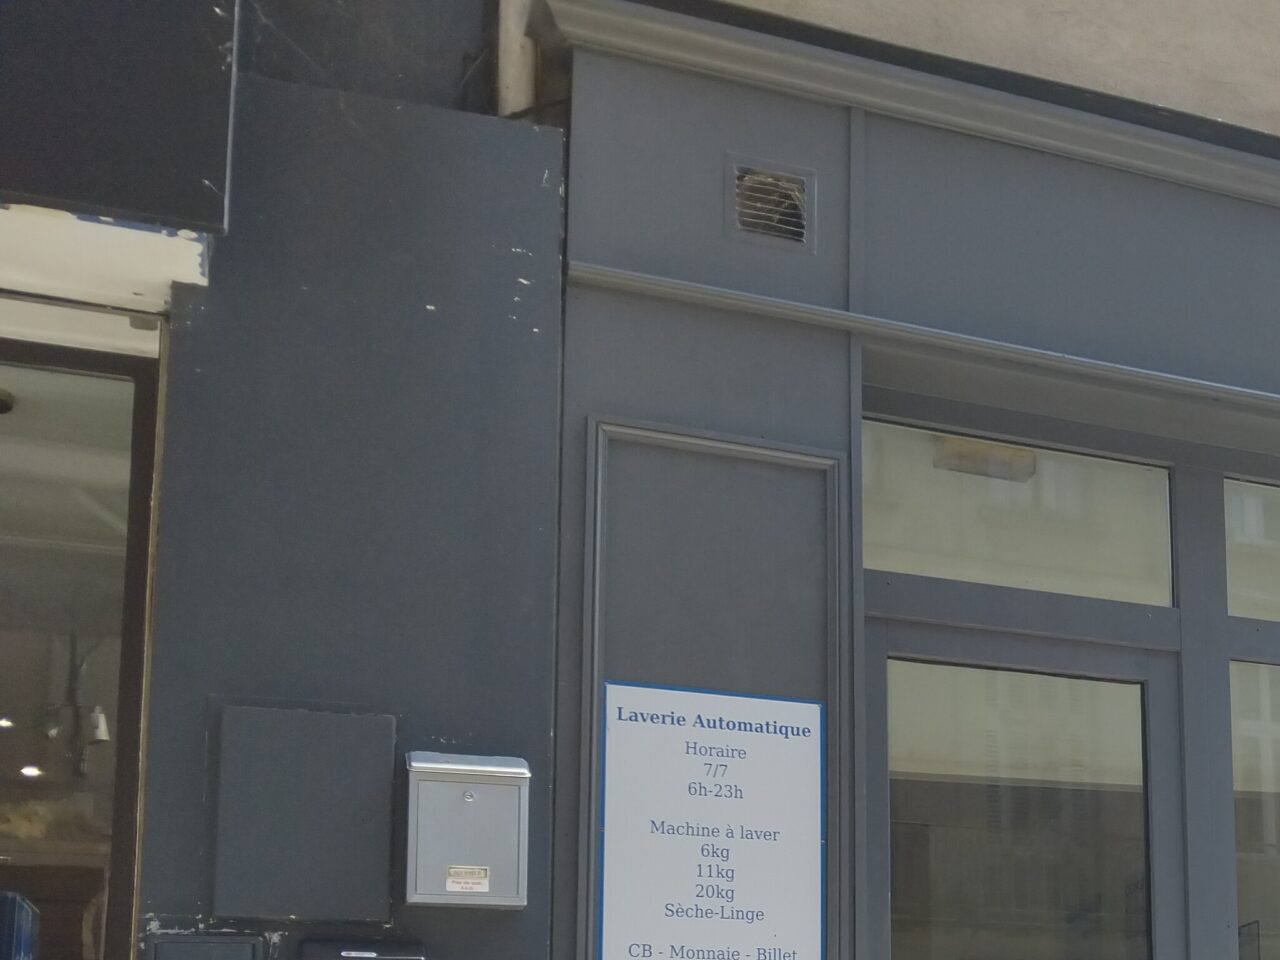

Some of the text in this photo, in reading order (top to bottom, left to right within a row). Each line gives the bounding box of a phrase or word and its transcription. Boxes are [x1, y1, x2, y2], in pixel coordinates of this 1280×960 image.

[616, 706, 812, 739] Laverie Automatique
[685, 741, 747, 760] Horaire
[703, 763, 728, 778] 7/7
[688, 782, 743, 799] 6h-23h
[649, 820, 780, 842] Machine à laver
[700, 844, 730, 861] 6kg
[696, 864, 735, 882] 11kg
[695, 884, 735, 902] 20kg
[664, 903, 765, 924] Sèche-Linge
[628, 944, 652, 958] CB
